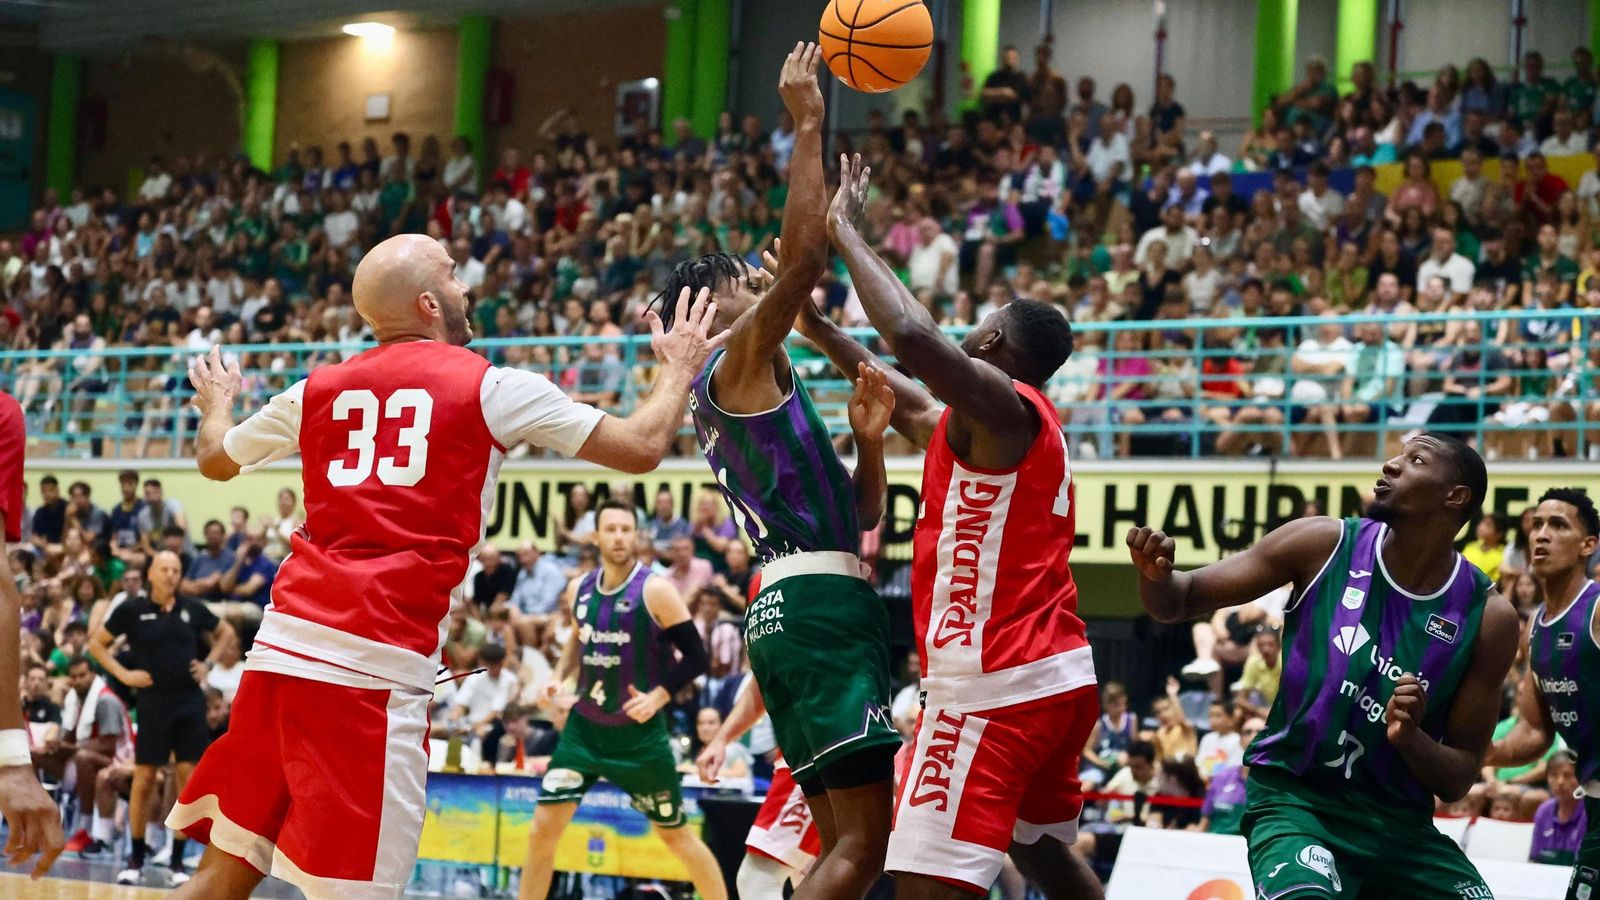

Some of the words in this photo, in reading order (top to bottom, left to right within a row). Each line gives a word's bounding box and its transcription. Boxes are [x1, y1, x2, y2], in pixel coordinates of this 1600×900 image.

[327, 388, 434, 488] 33
[933, 480, 1003, 649] SPALDING
[759, 606, 784, 622] SOL
[590, 680, 606, 706] 4
